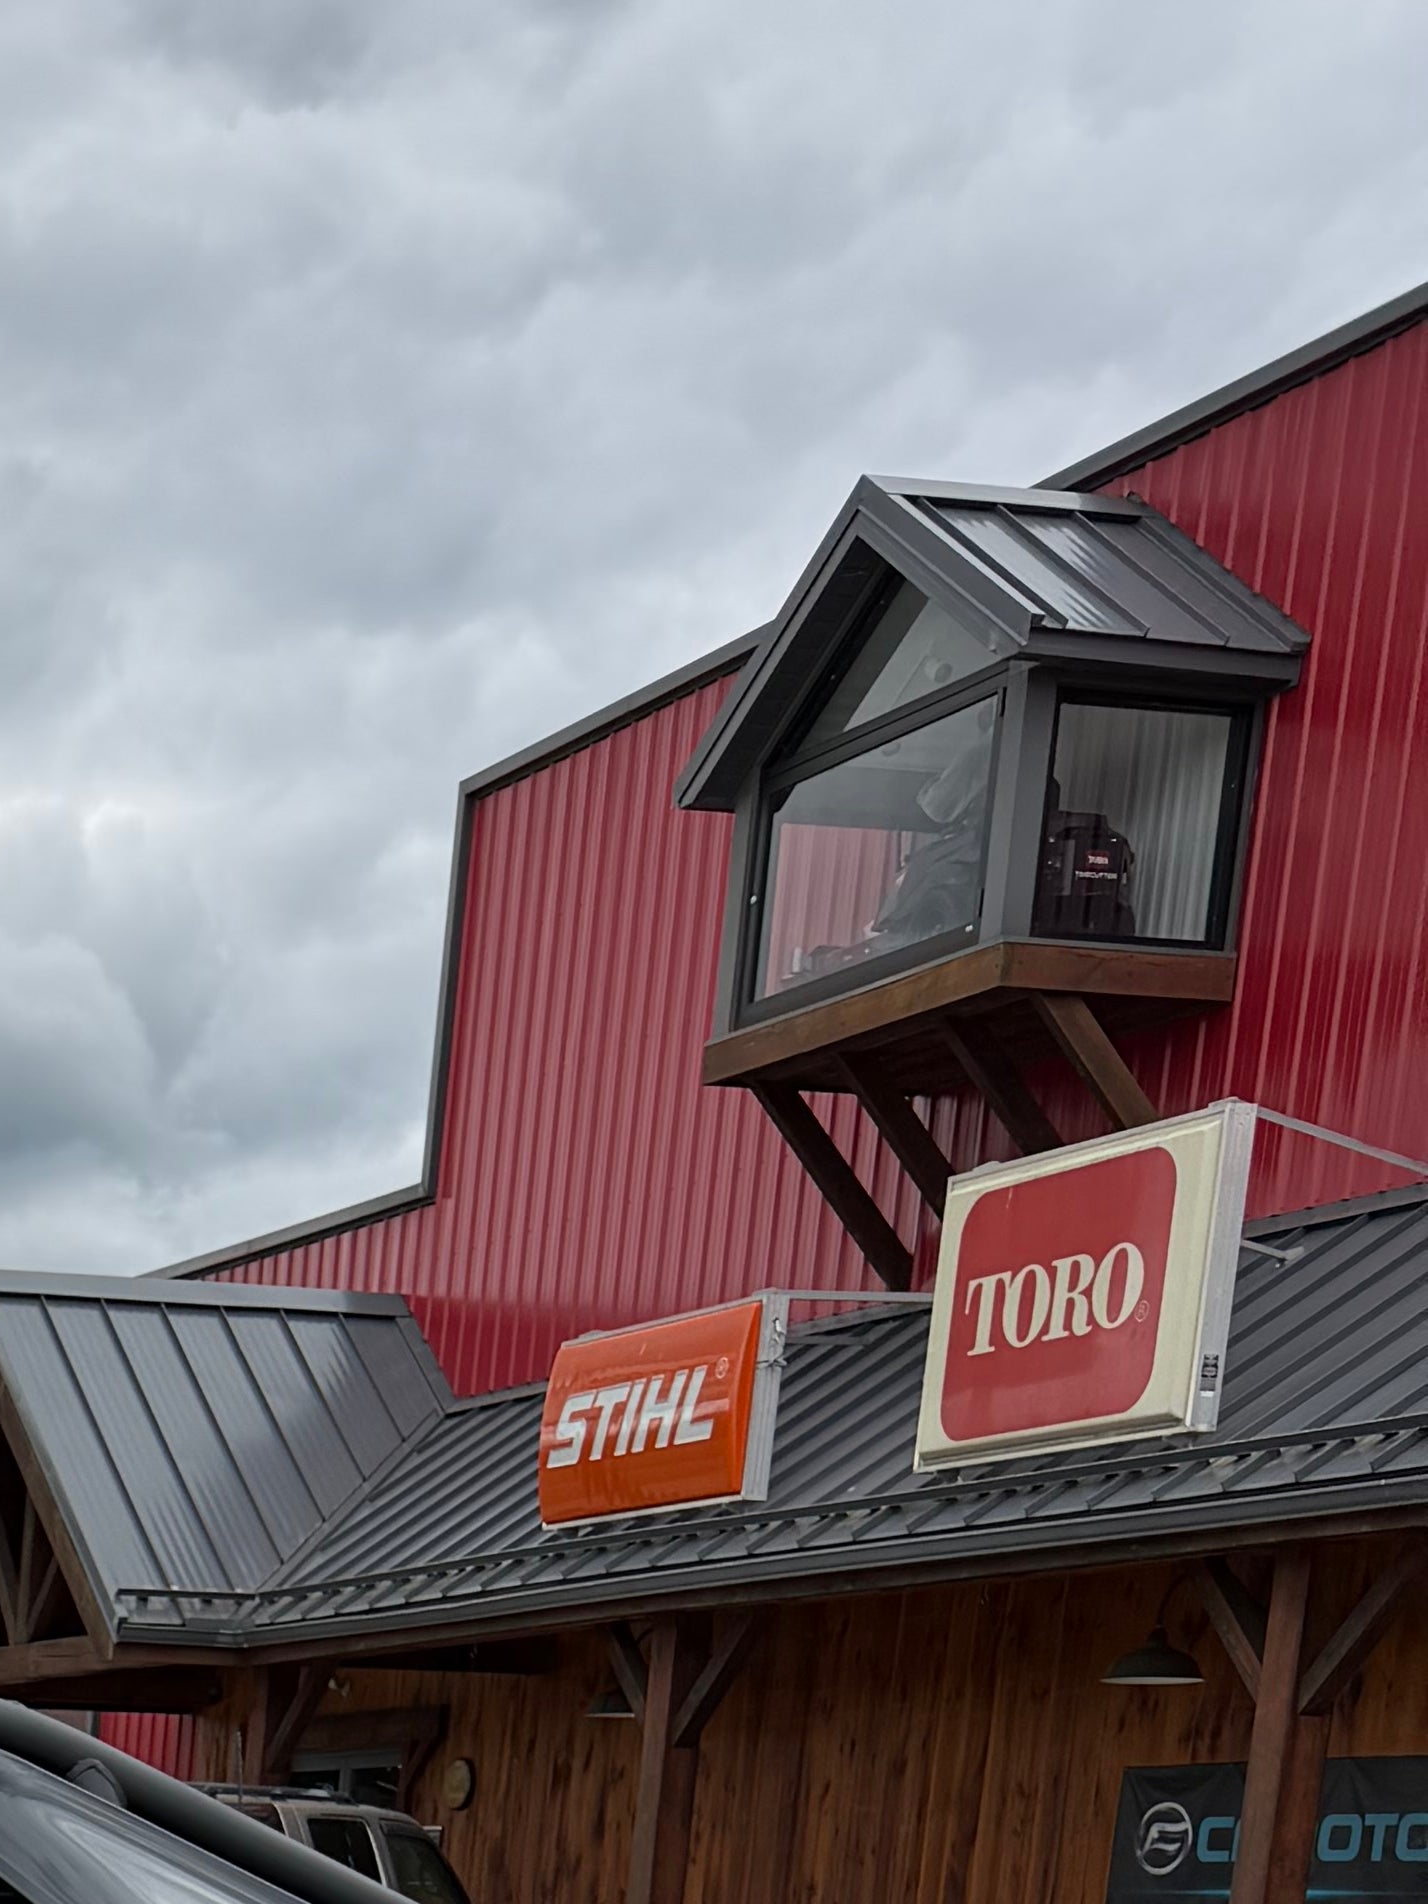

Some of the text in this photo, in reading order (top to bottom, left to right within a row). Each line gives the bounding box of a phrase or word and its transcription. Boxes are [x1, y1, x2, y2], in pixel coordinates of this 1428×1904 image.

[964, 1240, 1144, 1357] TORO
[546, 1364, 717, 1469] STIHL
[1197, 1812, 1428, 1863] COTO
